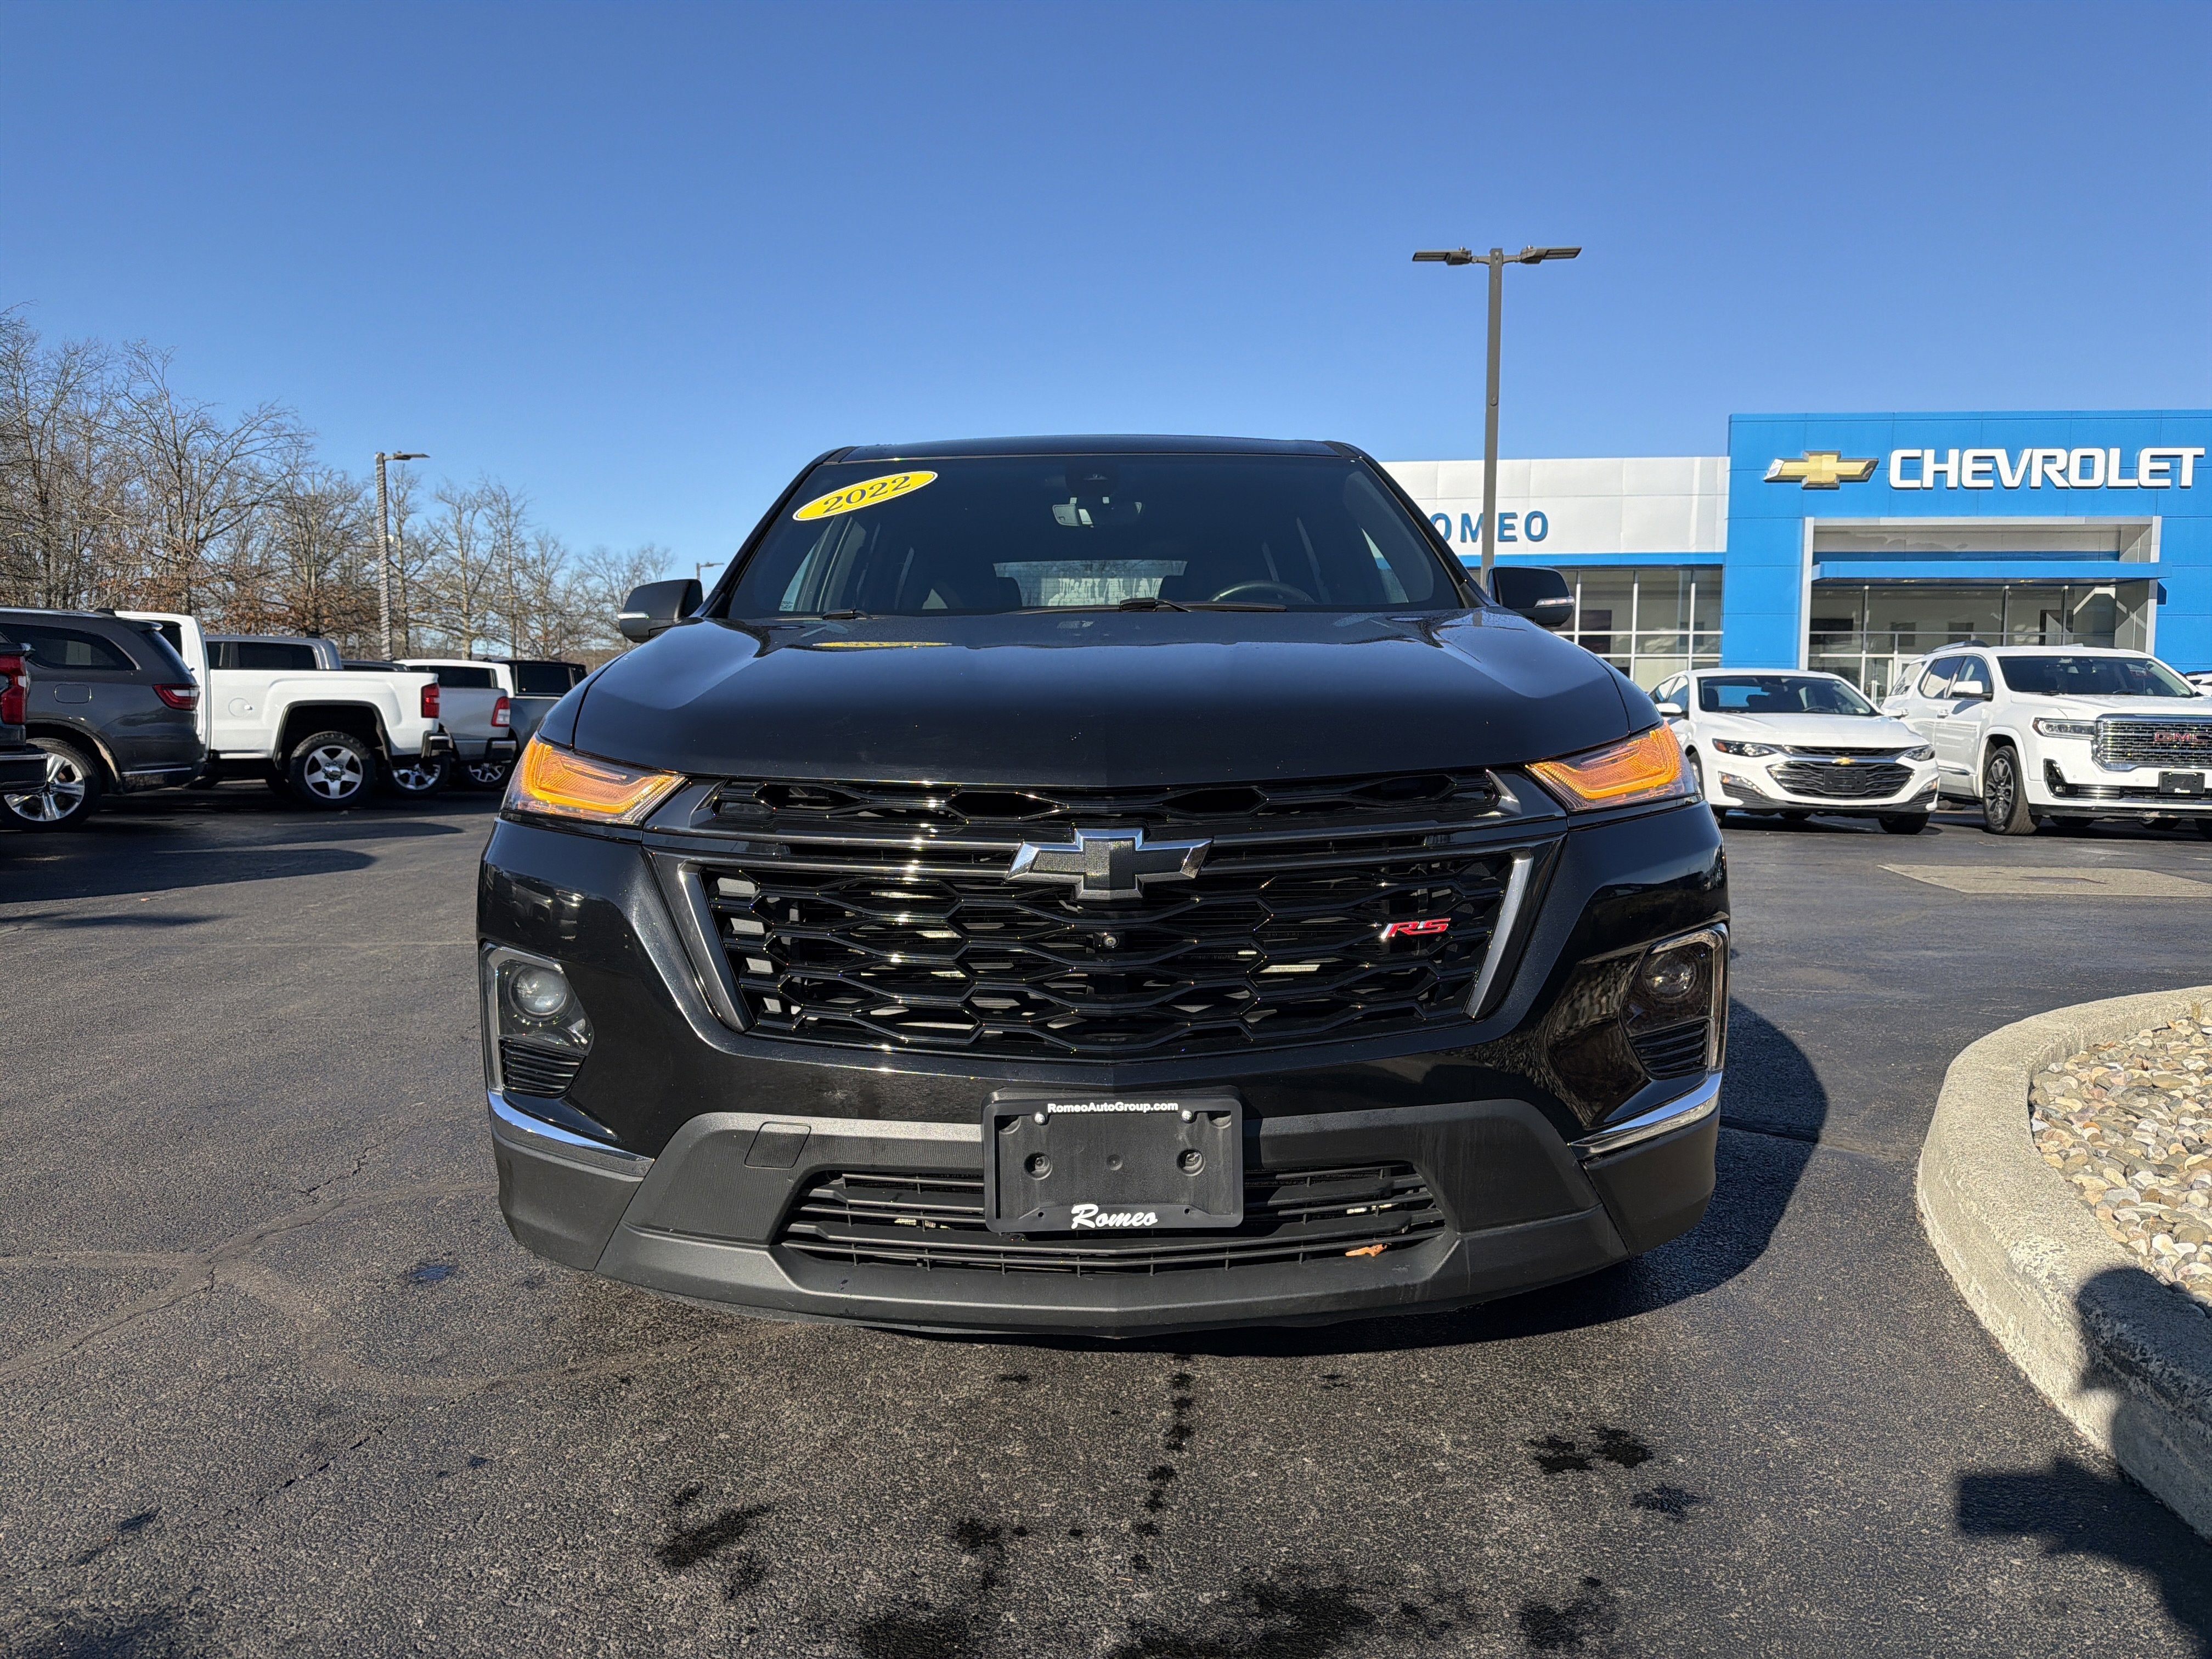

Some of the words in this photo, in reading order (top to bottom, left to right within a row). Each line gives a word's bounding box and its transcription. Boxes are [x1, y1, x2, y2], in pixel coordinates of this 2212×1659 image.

[1889, 448, 2205, 489] CHEVROLET
[823, 476, 911, 514] 2022
[1430, 511, 1548, 543] OMEO
[2154, 732, 2209, 742] GMC
[1380, 918, 1451, 940] RS
[1047, 1101, 1178, 1113] RomeoAutoGroup.com
[1071, 1204, 1158, 1229] Romeo
